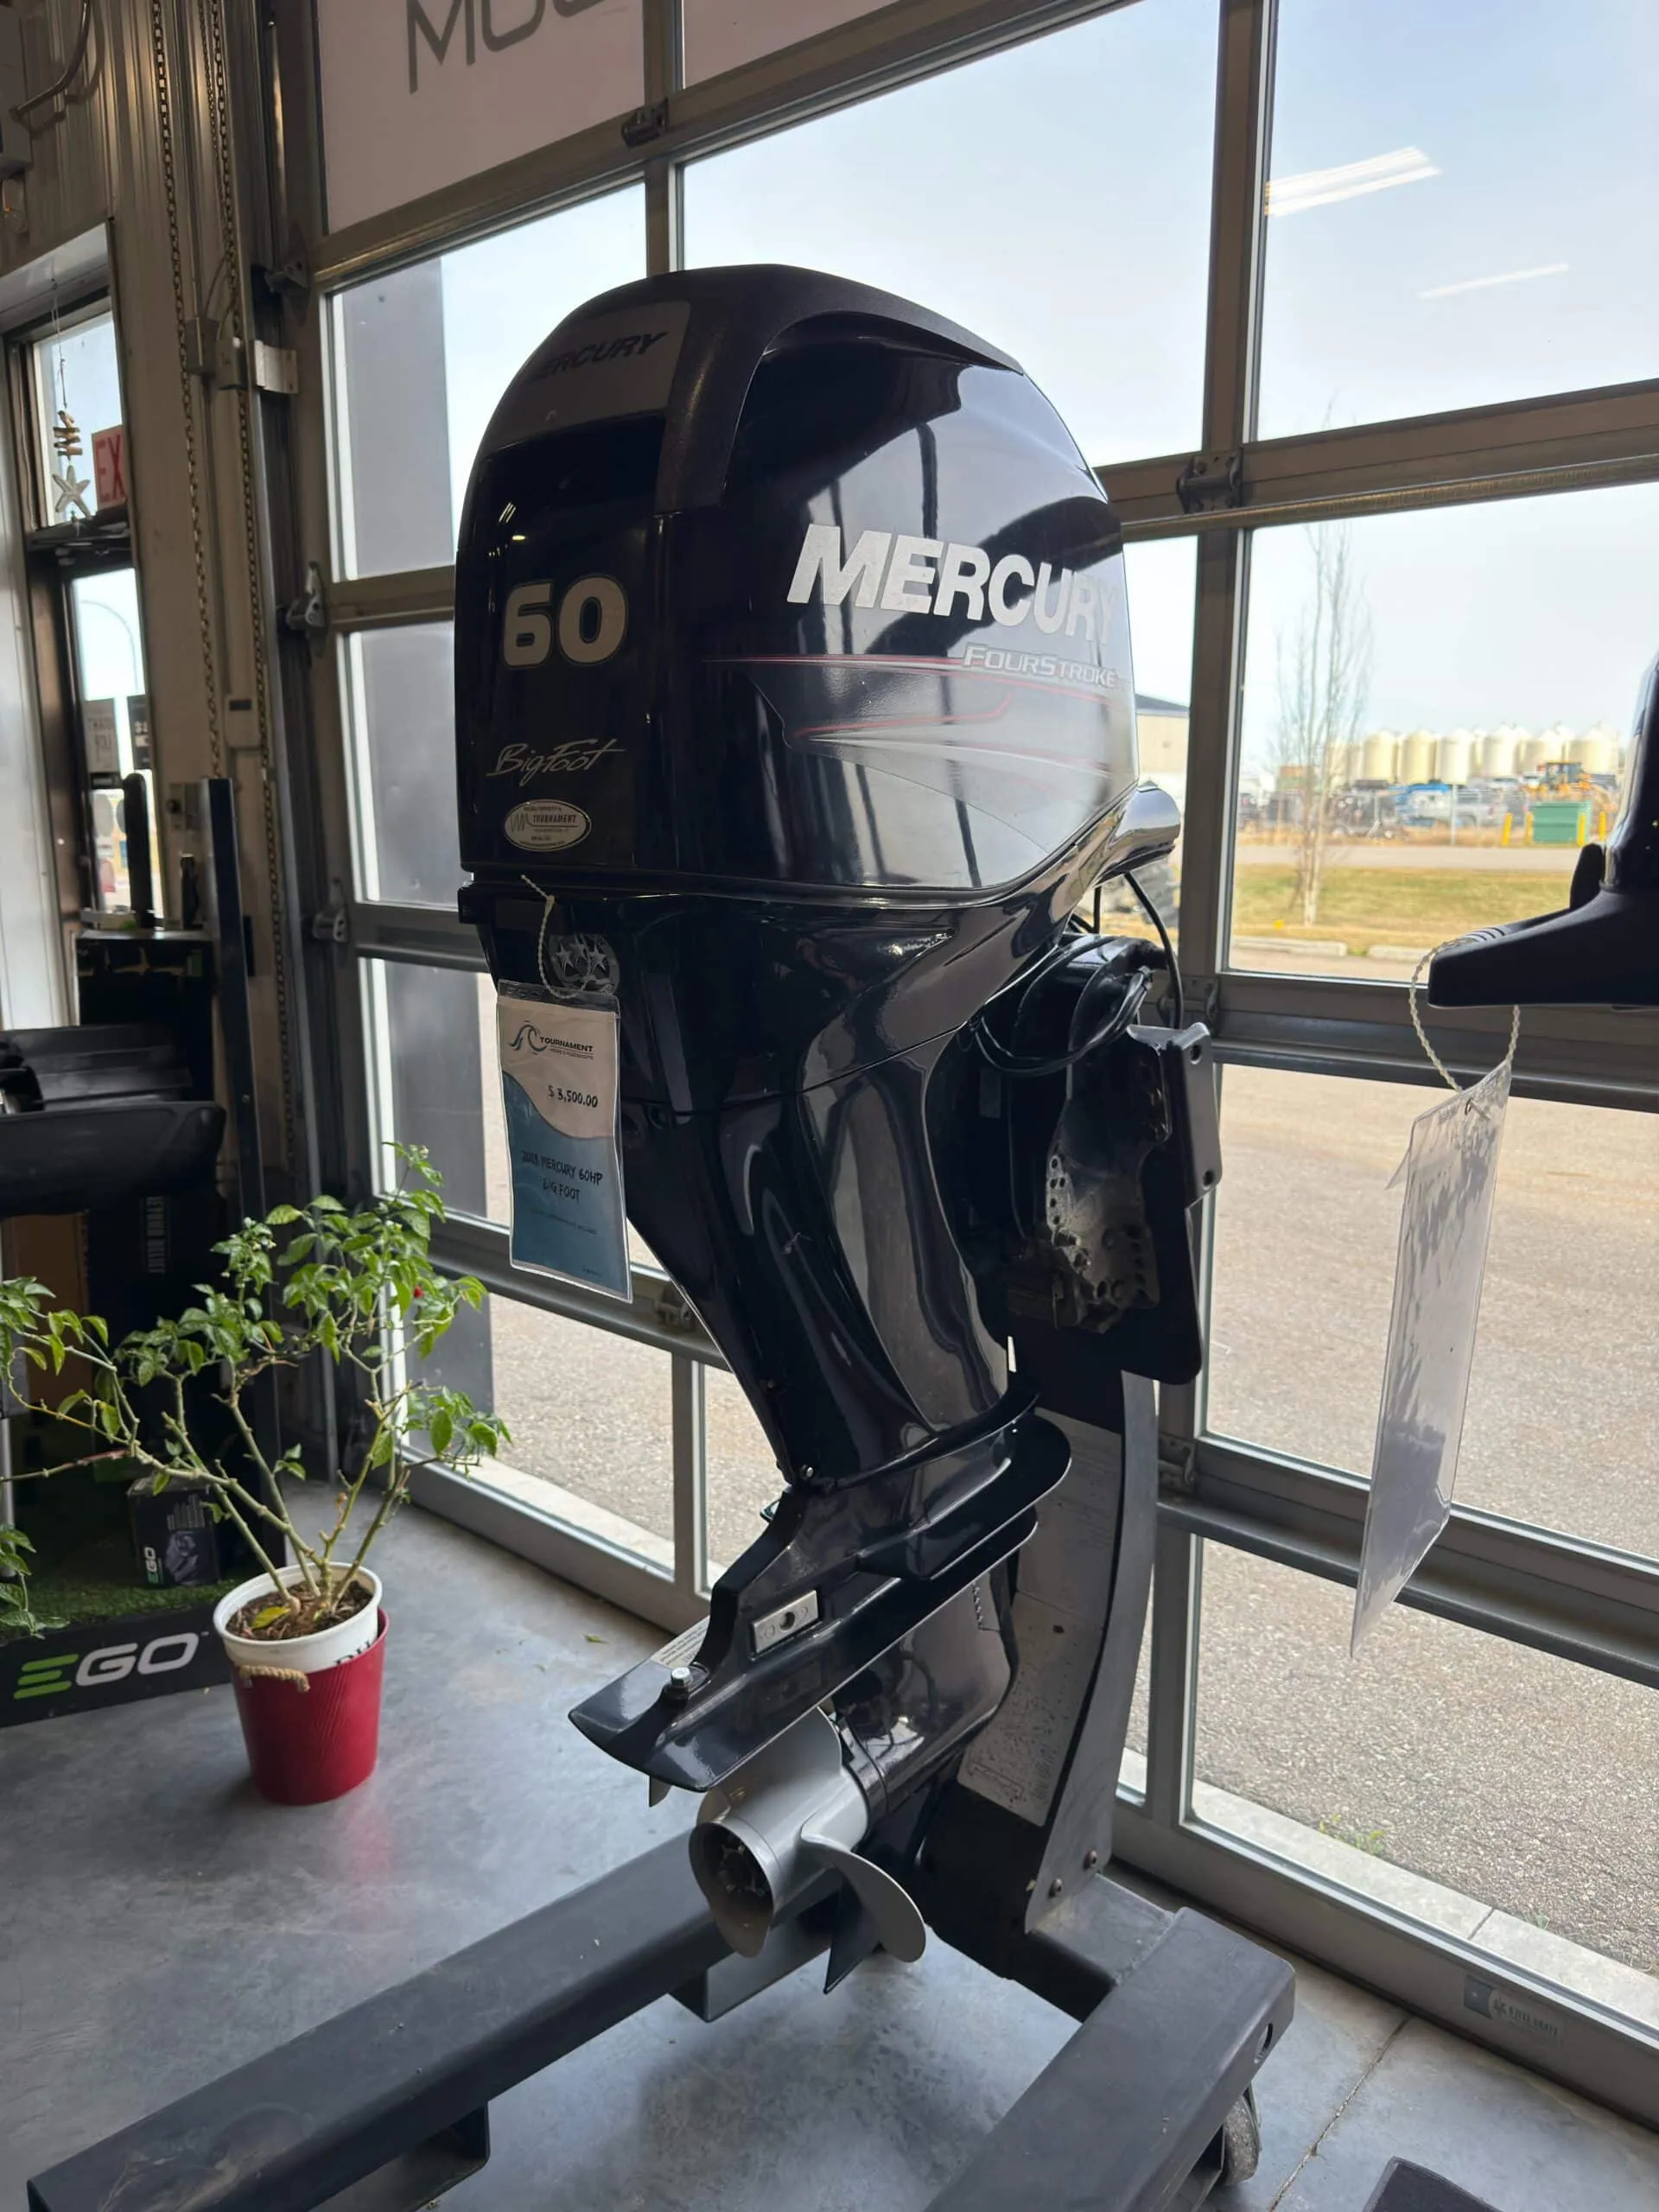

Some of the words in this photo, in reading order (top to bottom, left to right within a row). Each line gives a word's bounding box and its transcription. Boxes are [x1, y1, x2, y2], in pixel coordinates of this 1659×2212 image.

[531, 330, 669, 382] ERCURY
[787, 524, 1119, 646] MERCURY
[501, 572, 629, 670] 60
[533, 814, 578, 823] TOURNAMENT
[539, 1036, 594, 1052] TOURNAMENT
[556, 1087, 599, 1109] 3,500.00
[541, 1154, 577, 1179] MERCURY
[578, 1167, 603, 1186] 60HP
[558, 1183, 582, 1204] FOOT
[143, 1546, 159, 1584] EGO
[13, 1631, 200, 1700] EGO
